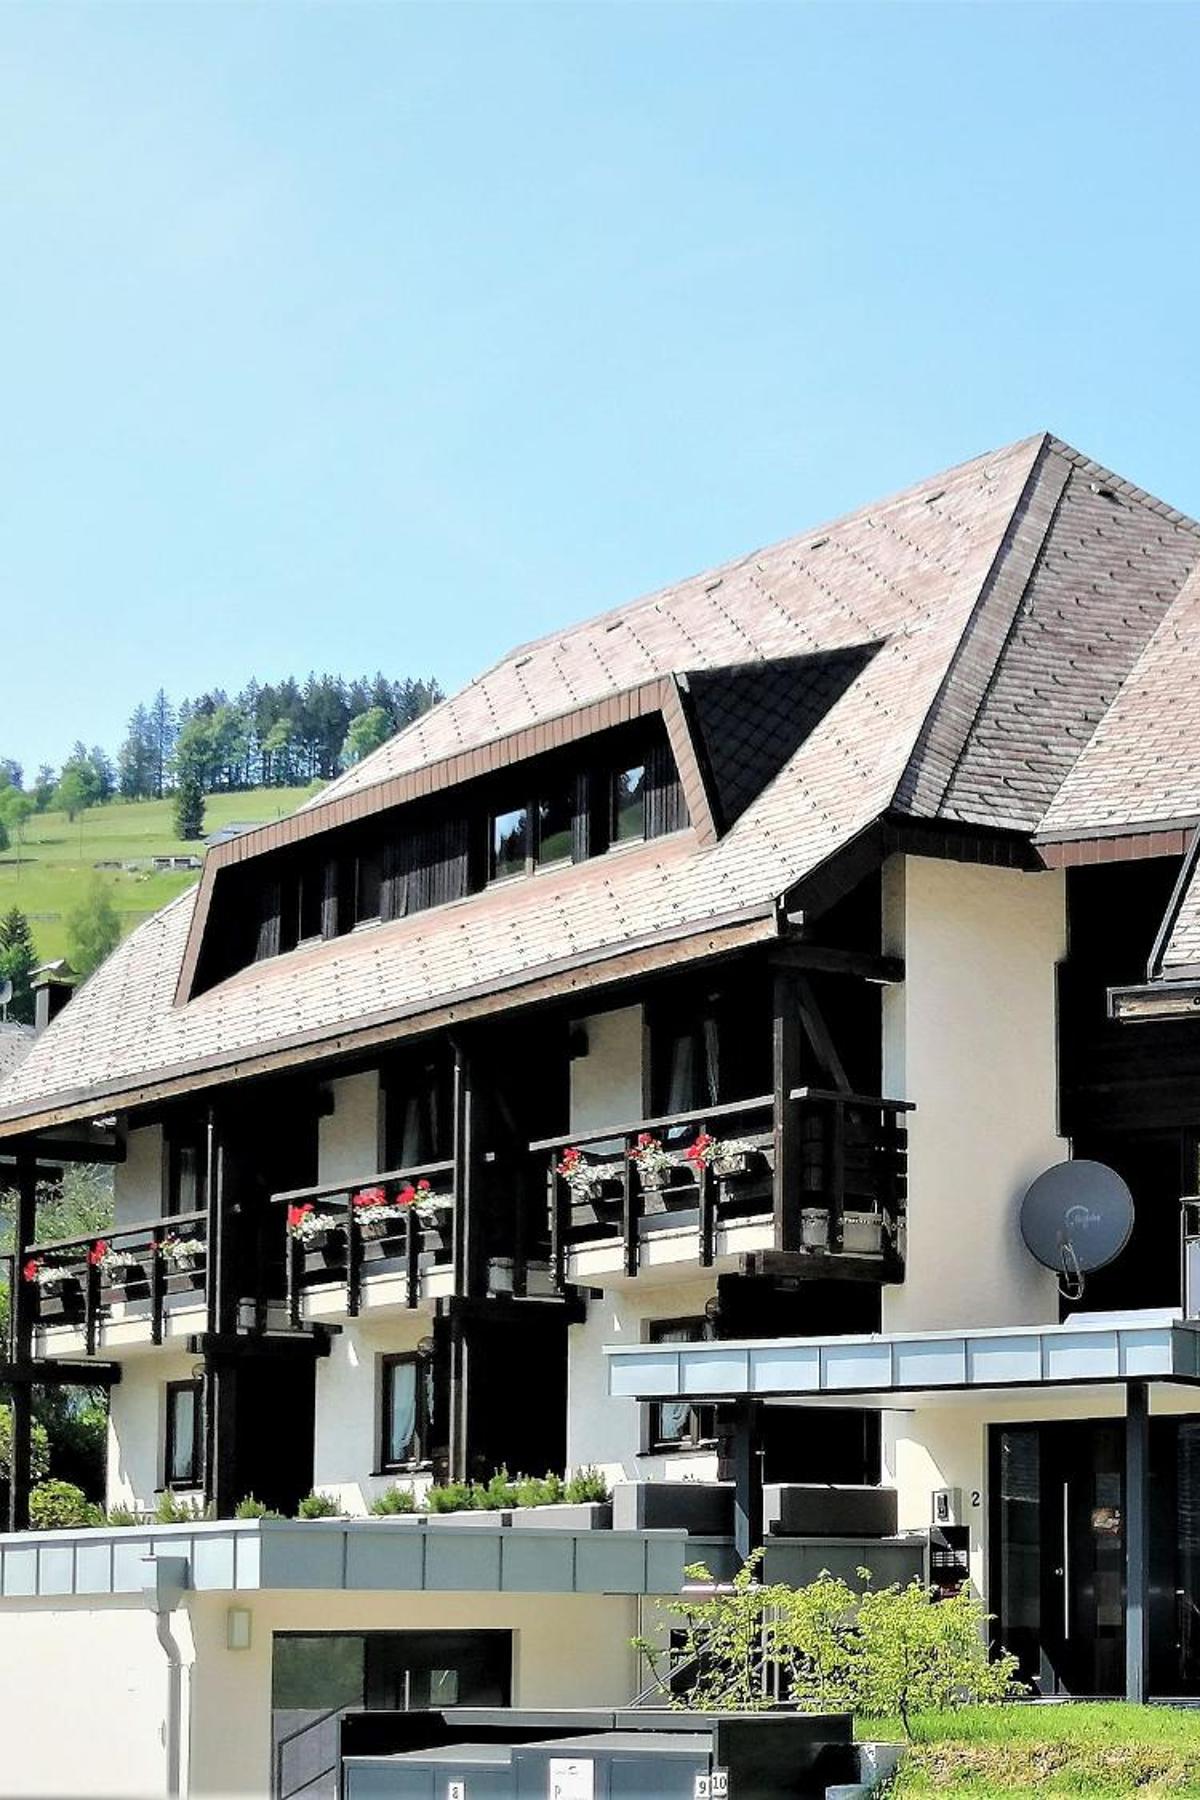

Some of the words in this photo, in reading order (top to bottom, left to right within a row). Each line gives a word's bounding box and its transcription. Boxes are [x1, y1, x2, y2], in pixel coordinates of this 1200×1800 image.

[971, 1491, 981, 1507] 2
[699, 1780, 707, 1795] 9
[713, 1775, 727, 1790] 10
[451, 1786, 460, 1800] 8
